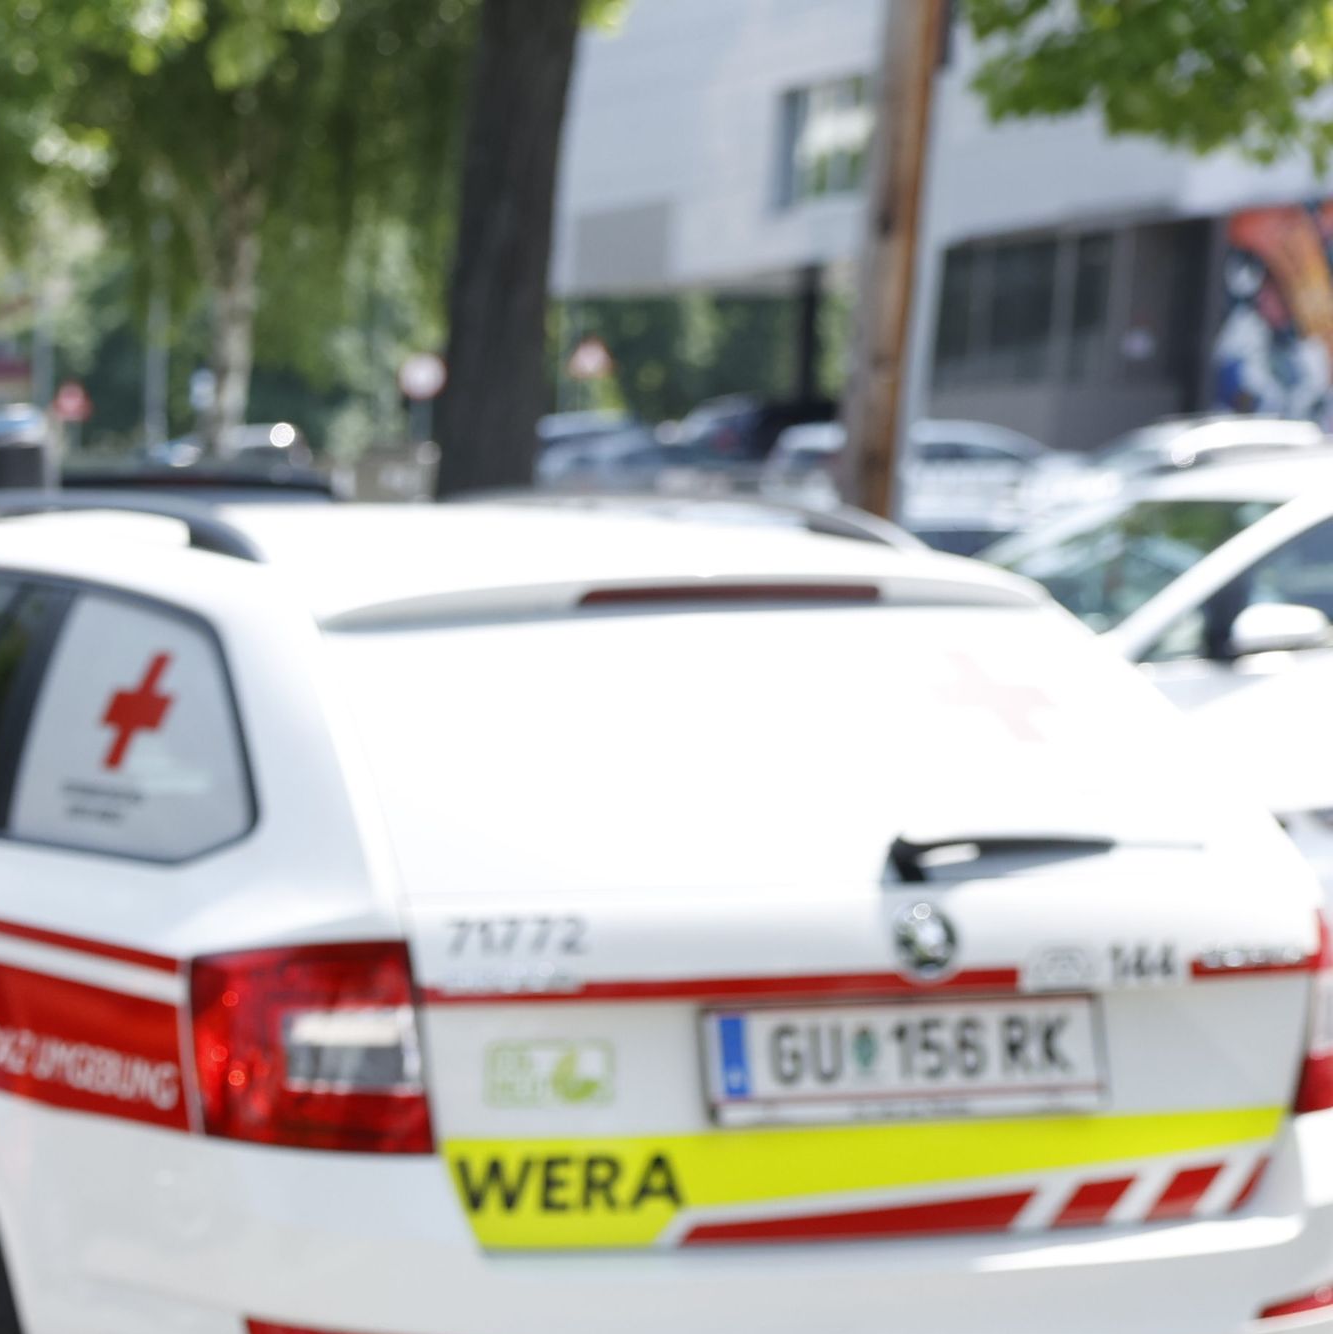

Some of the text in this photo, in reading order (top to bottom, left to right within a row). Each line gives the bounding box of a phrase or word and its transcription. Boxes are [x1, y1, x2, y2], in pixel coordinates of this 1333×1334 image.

[445, 915, 589, 957] 71772
[769, 1022, 845, 1085] GU
[1002, 1011, 1072, 1071] RK
[455, 1151, 685, 1214] WERA
